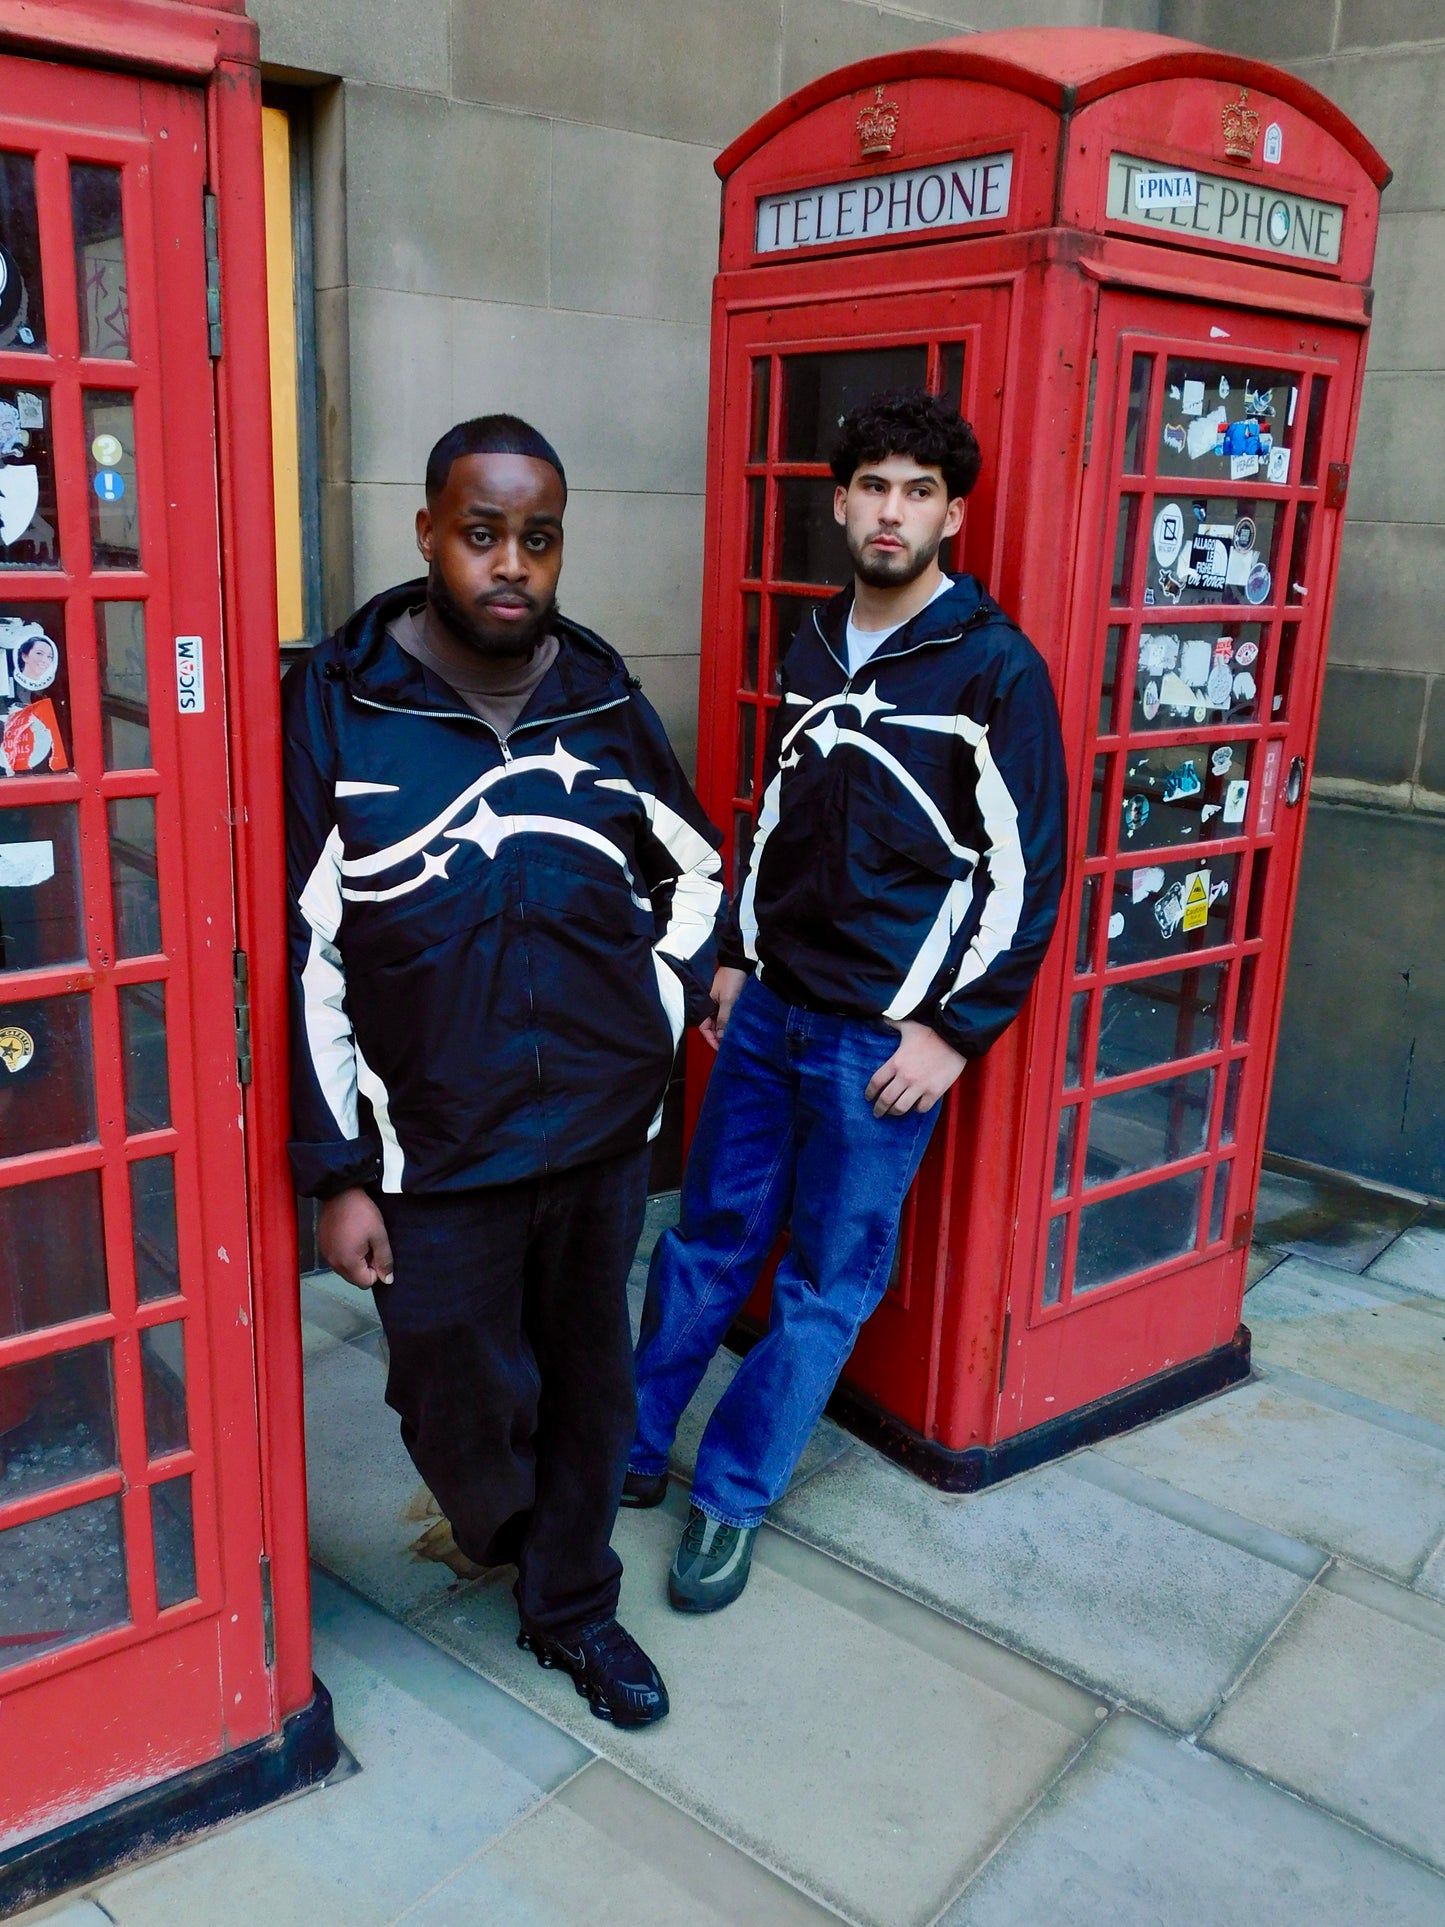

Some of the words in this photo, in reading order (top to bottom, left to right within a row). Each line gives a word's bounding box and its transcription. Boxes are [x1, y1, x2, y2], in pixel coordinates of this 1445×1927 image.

[769, 163, 1004, 246] TELEPHONE
[178, 641, 196, 709] SJCAM
[1259, 752, 1275, 823] PULL
